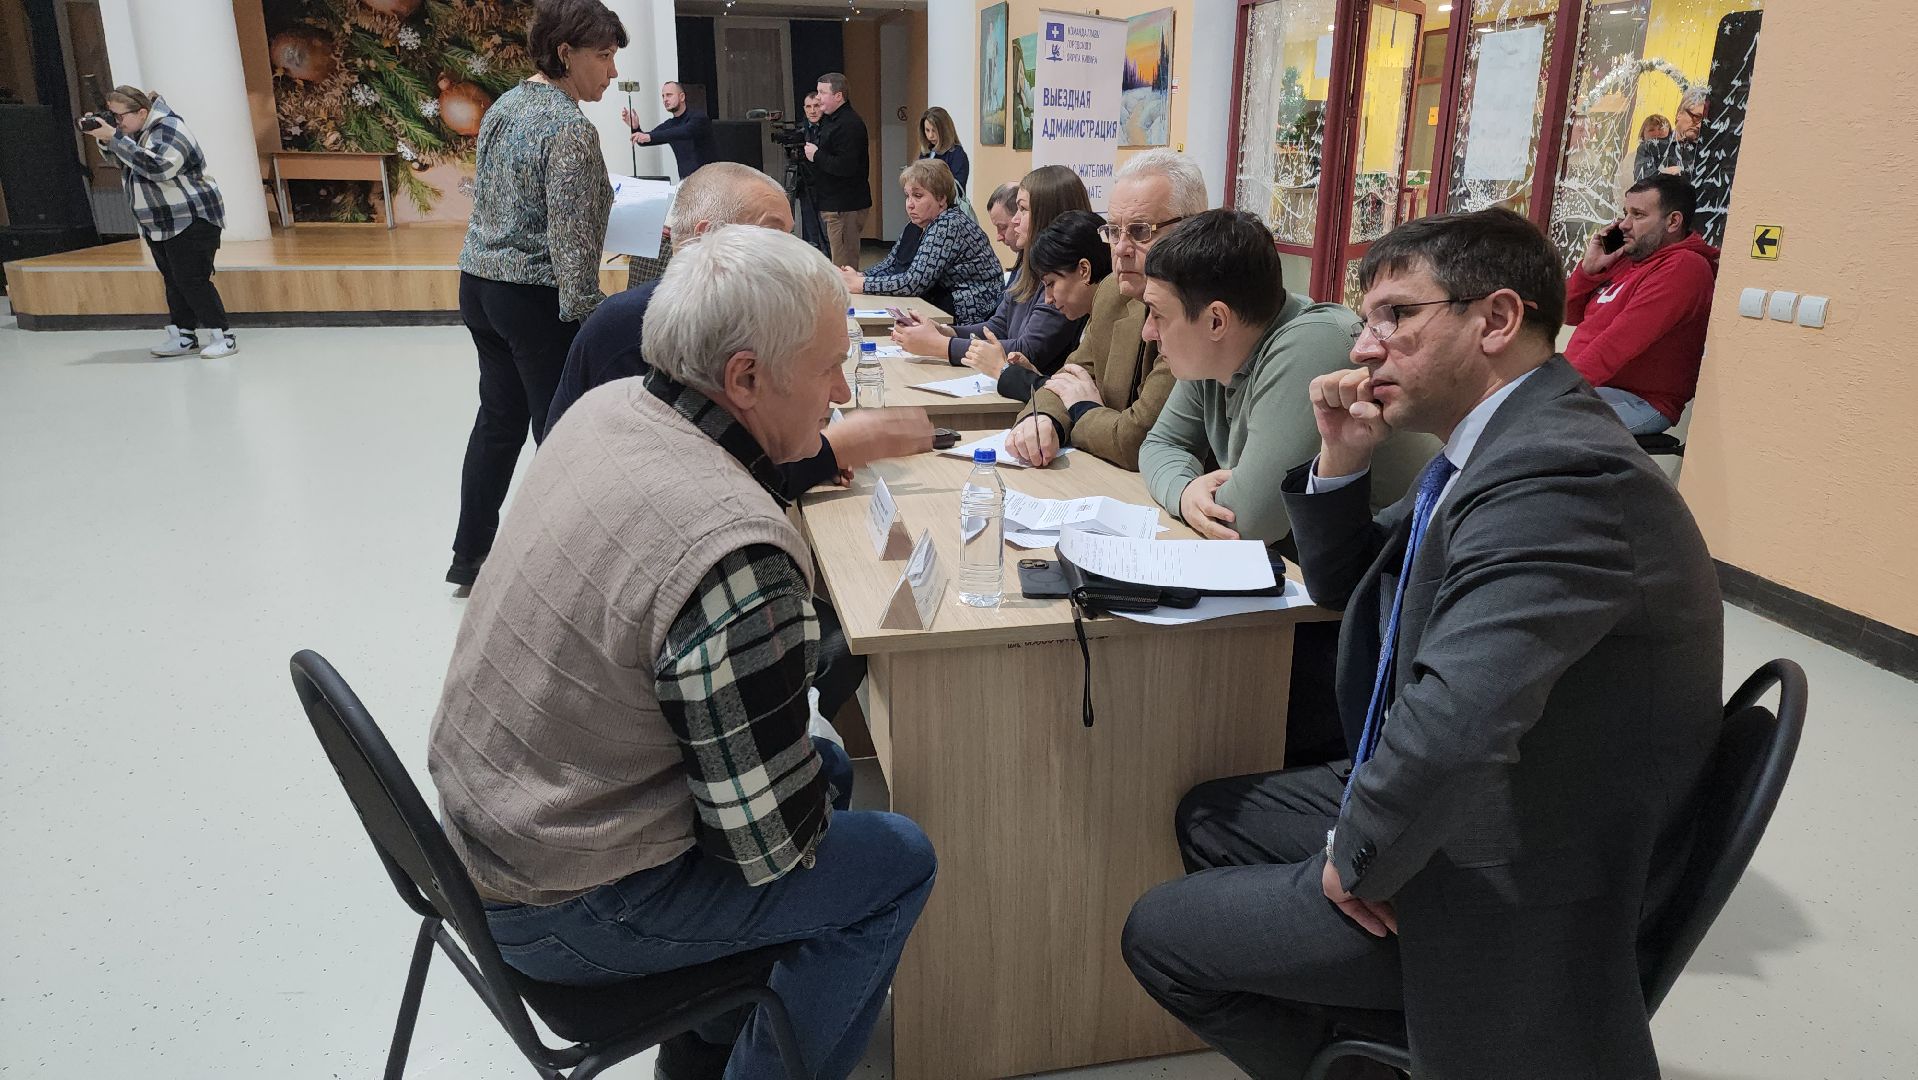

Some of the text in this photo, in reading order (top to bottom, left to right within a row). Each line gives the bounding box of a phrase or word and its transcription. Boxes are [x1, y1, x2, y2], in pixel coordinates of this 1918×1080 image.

[1043, 88, 1091, 110] ВЫЕЗДНАЯ
[1042, 119, 1117, 142] АДМИНИСТРАЦИЯ
[1079, 164, 1113, 177] ЖИТЕЛЯМИ
